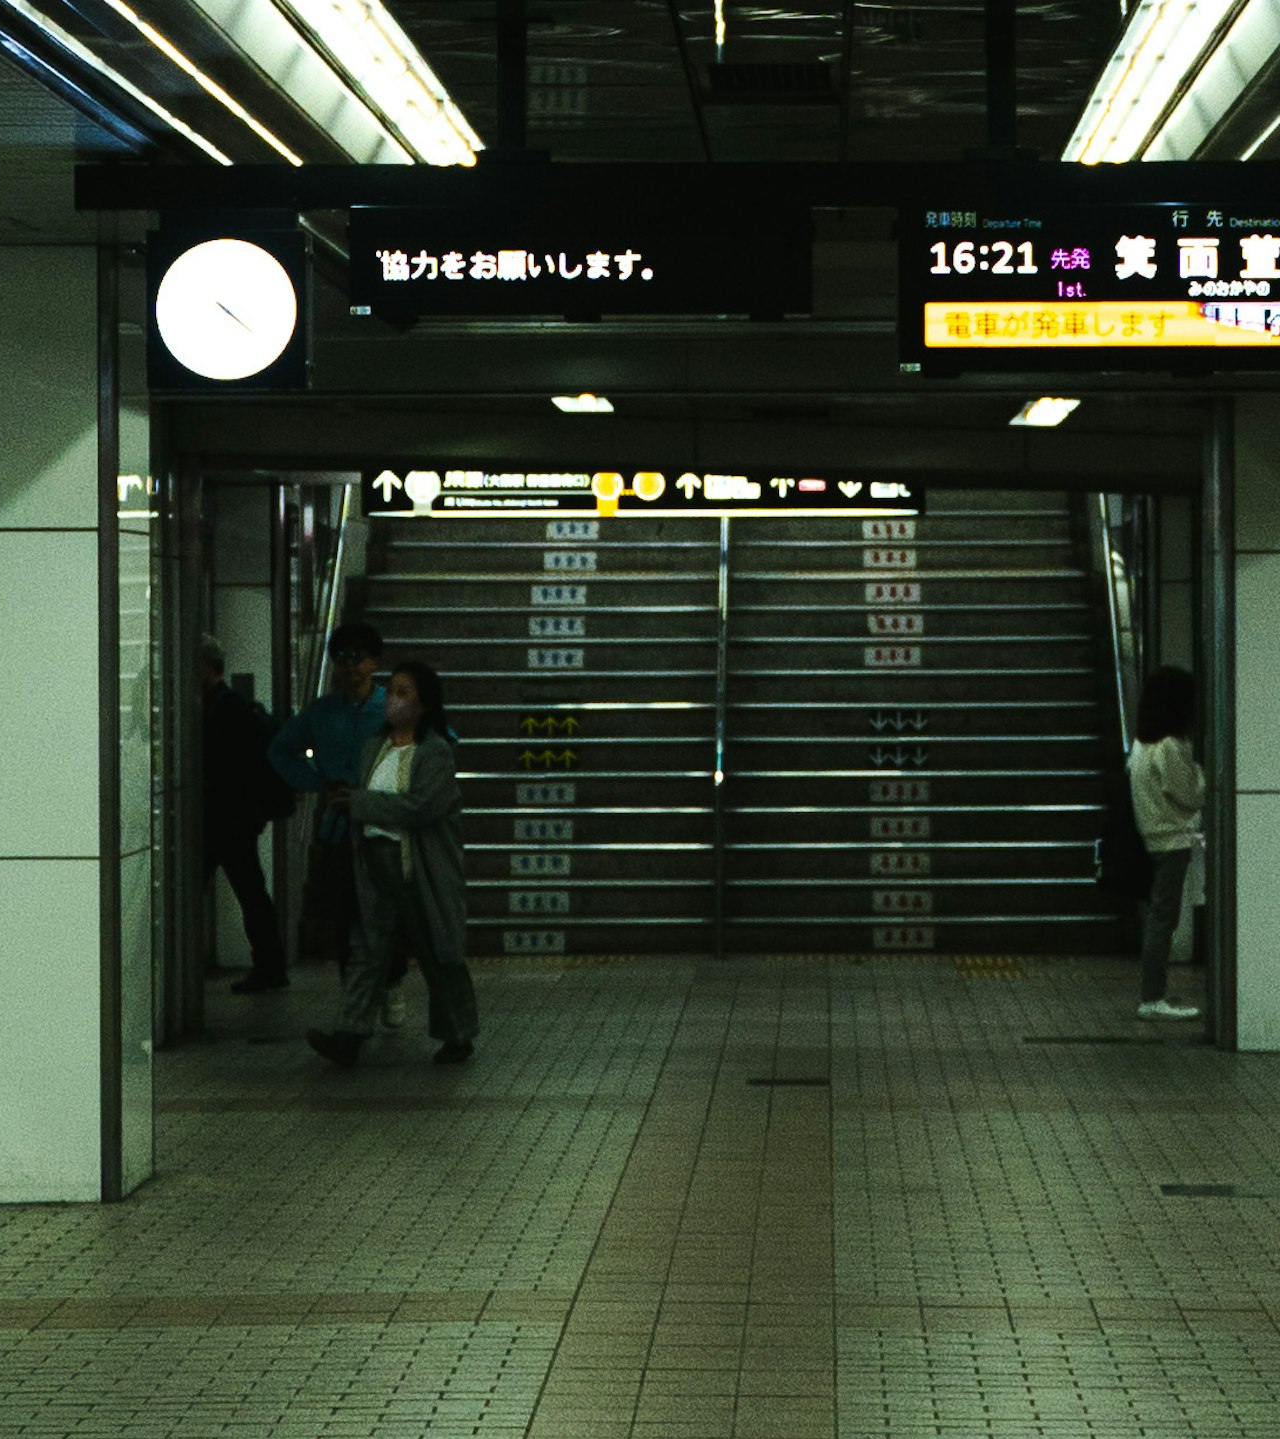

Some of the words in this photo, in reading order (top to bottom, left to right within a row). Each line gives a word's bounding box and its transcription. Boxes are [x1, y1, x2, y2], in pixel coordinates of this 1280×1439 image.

[925, 211, 977, 229] 発車時刻
[1023, 217, 1042, 228] Time
[376, 249, 654, 281] 協力をお願いします。
[929, 241, 1038, 274] 16:21
[1051, 248, 1091, 270] 先発
[1057, 281, 1087, 298] 1st.
[1188, 280, 1271, 298] みのおかやの
[945, 310, 1175, 338] 電車が発車します
